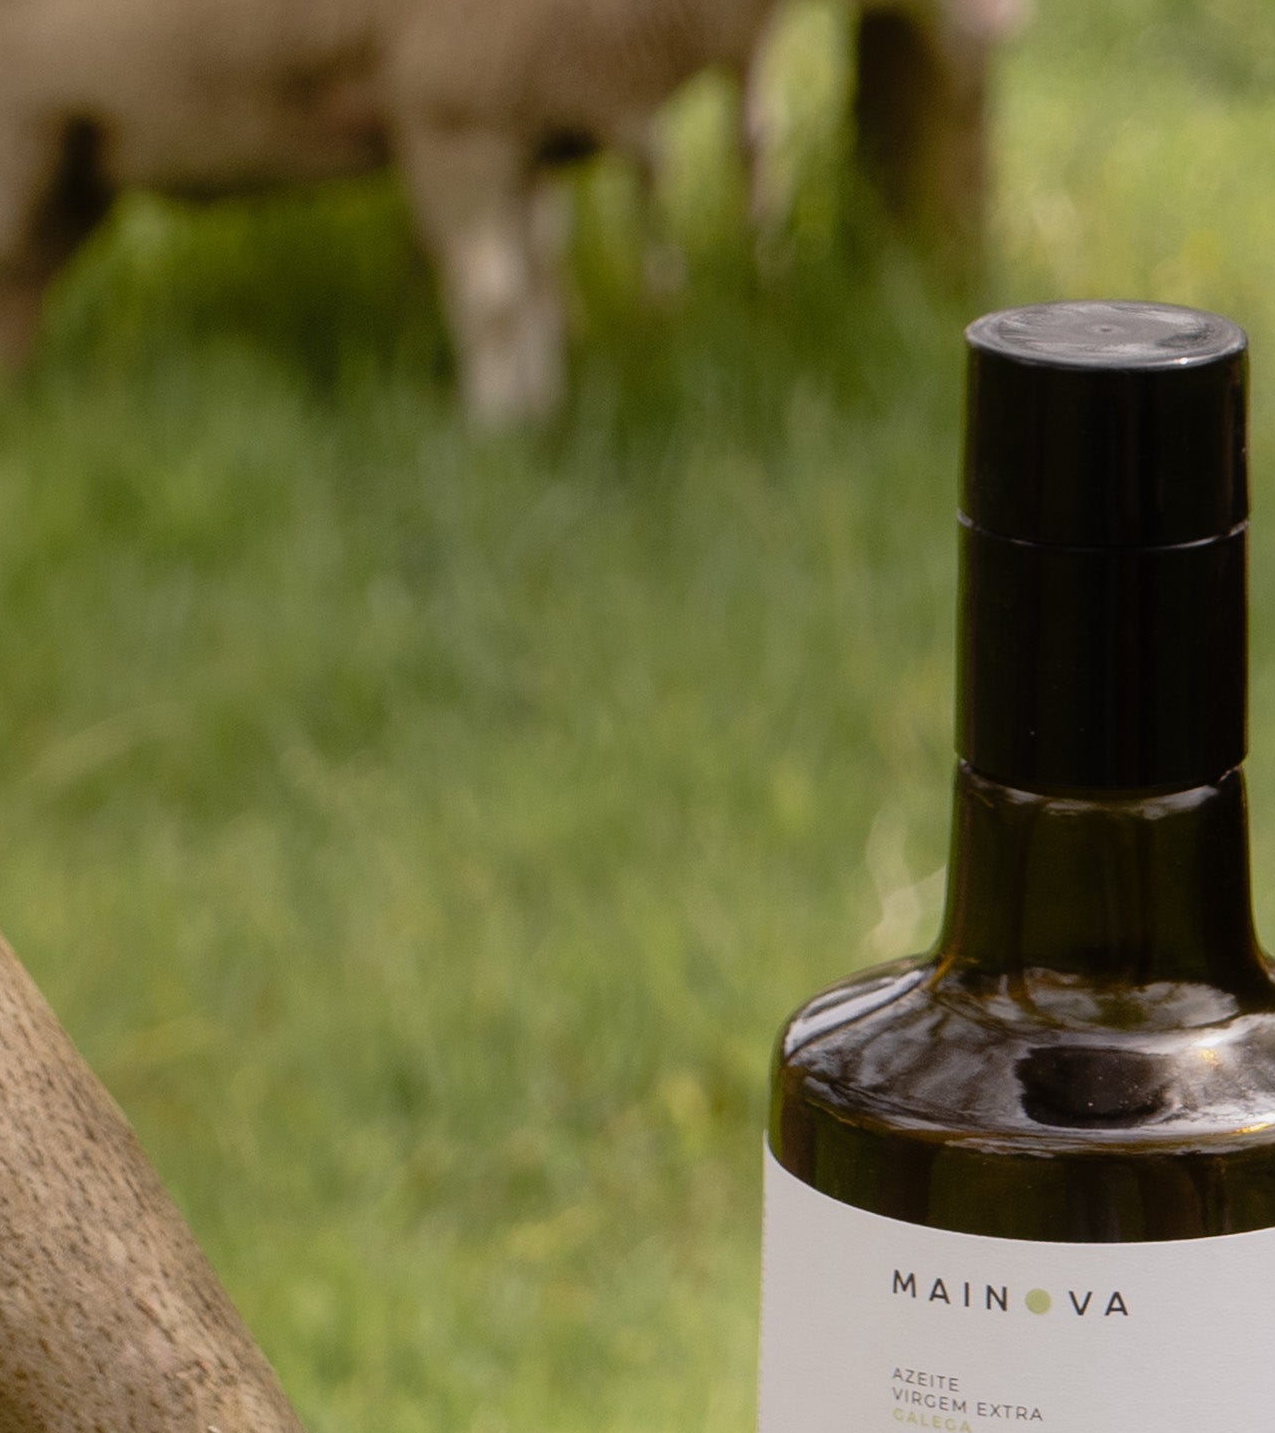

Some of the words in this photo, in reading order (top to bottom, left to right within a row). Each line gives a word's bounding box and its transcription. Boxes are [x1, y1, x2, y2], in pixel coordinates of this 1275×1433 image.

[892, 1366, 960, 1393] AZEITE
[891, 1386, 968, 1414] VIRGEM
[976, 1401, 1044, 1422] EXTRA
